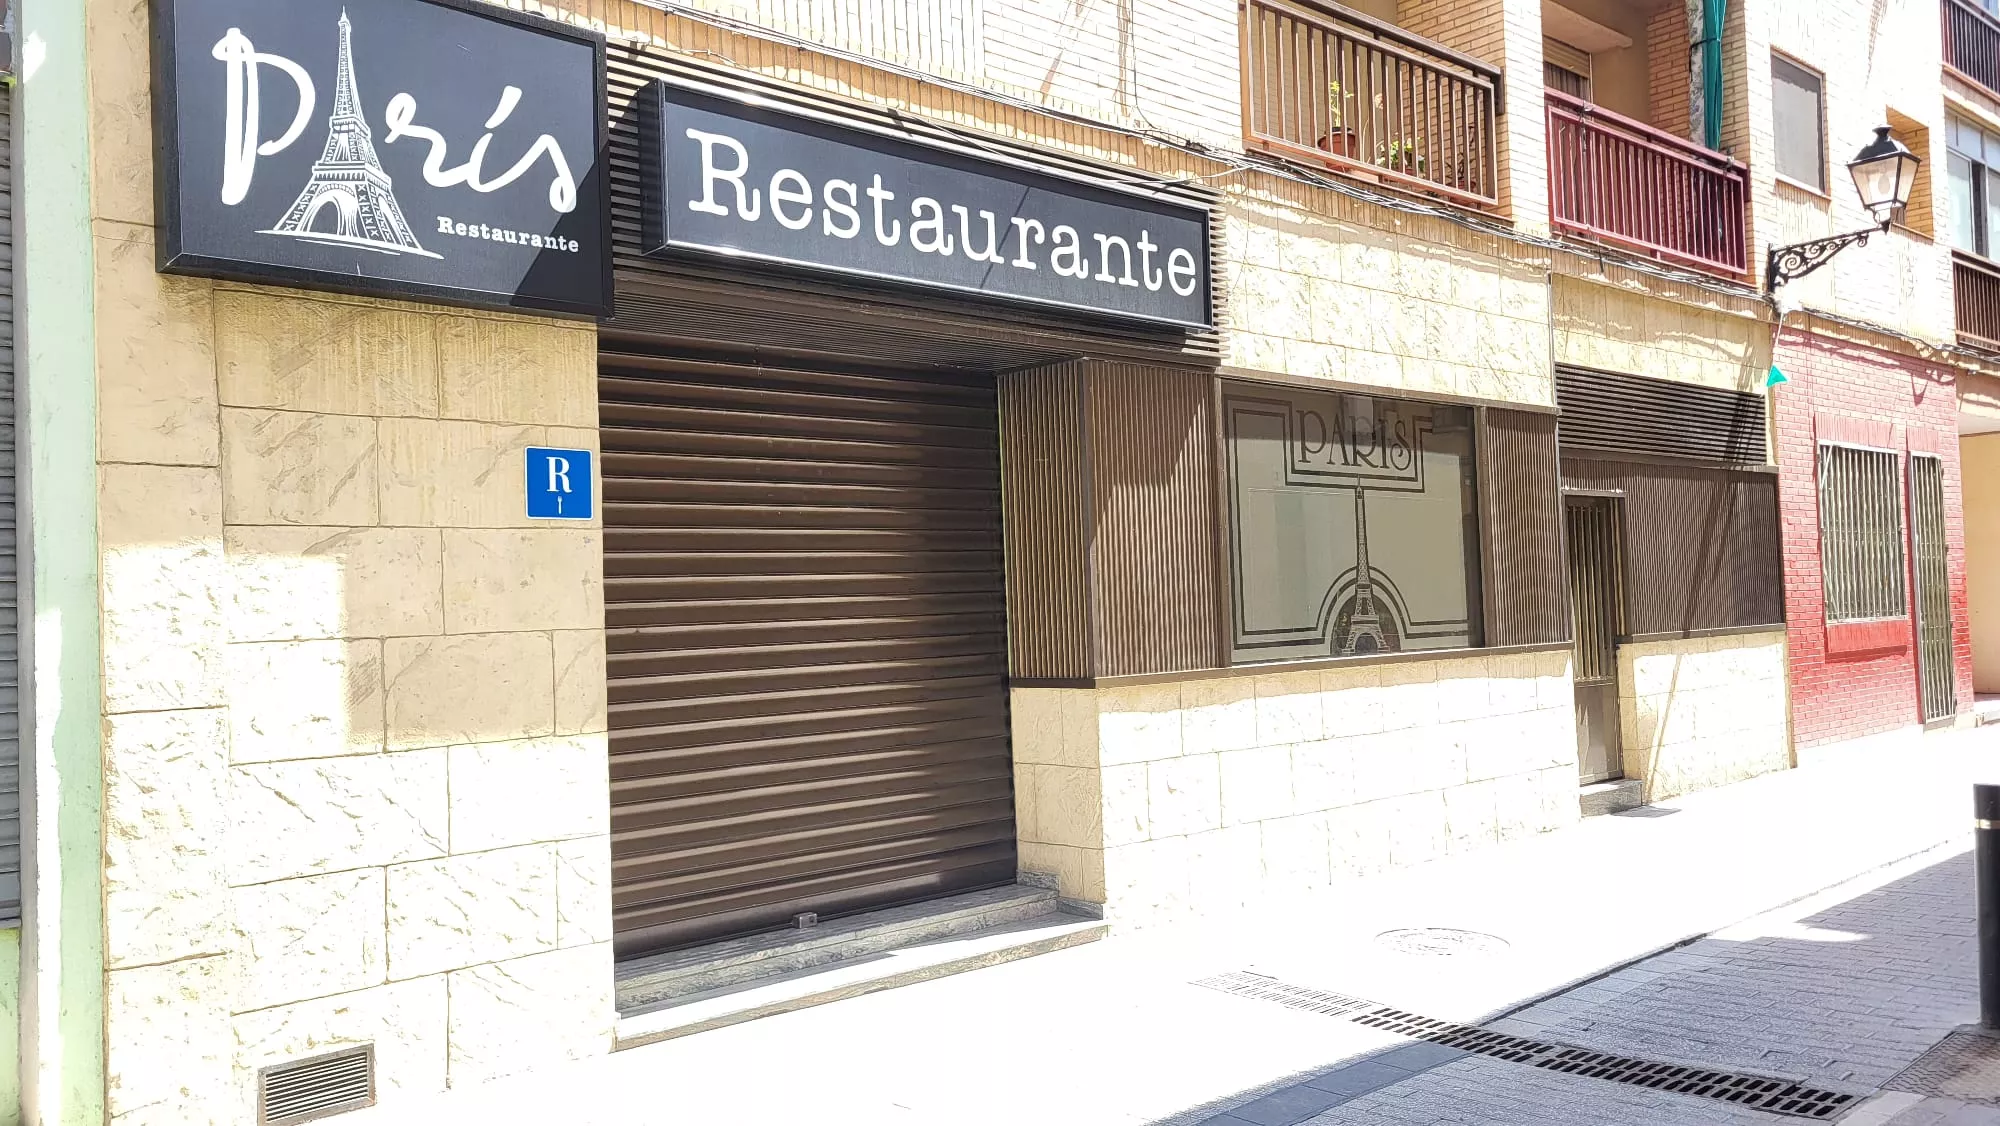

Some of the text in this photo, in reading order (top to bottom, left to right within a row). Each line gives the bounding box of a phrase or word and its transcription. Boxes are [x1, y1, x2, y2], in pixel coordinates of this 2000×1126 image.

[437, 215, 579, 253] Restaurante
[686, 127, 1198, 297] Restaurante
[1296, 409, 1412, 471] PARIS
[545, 456, 573, 493] R
